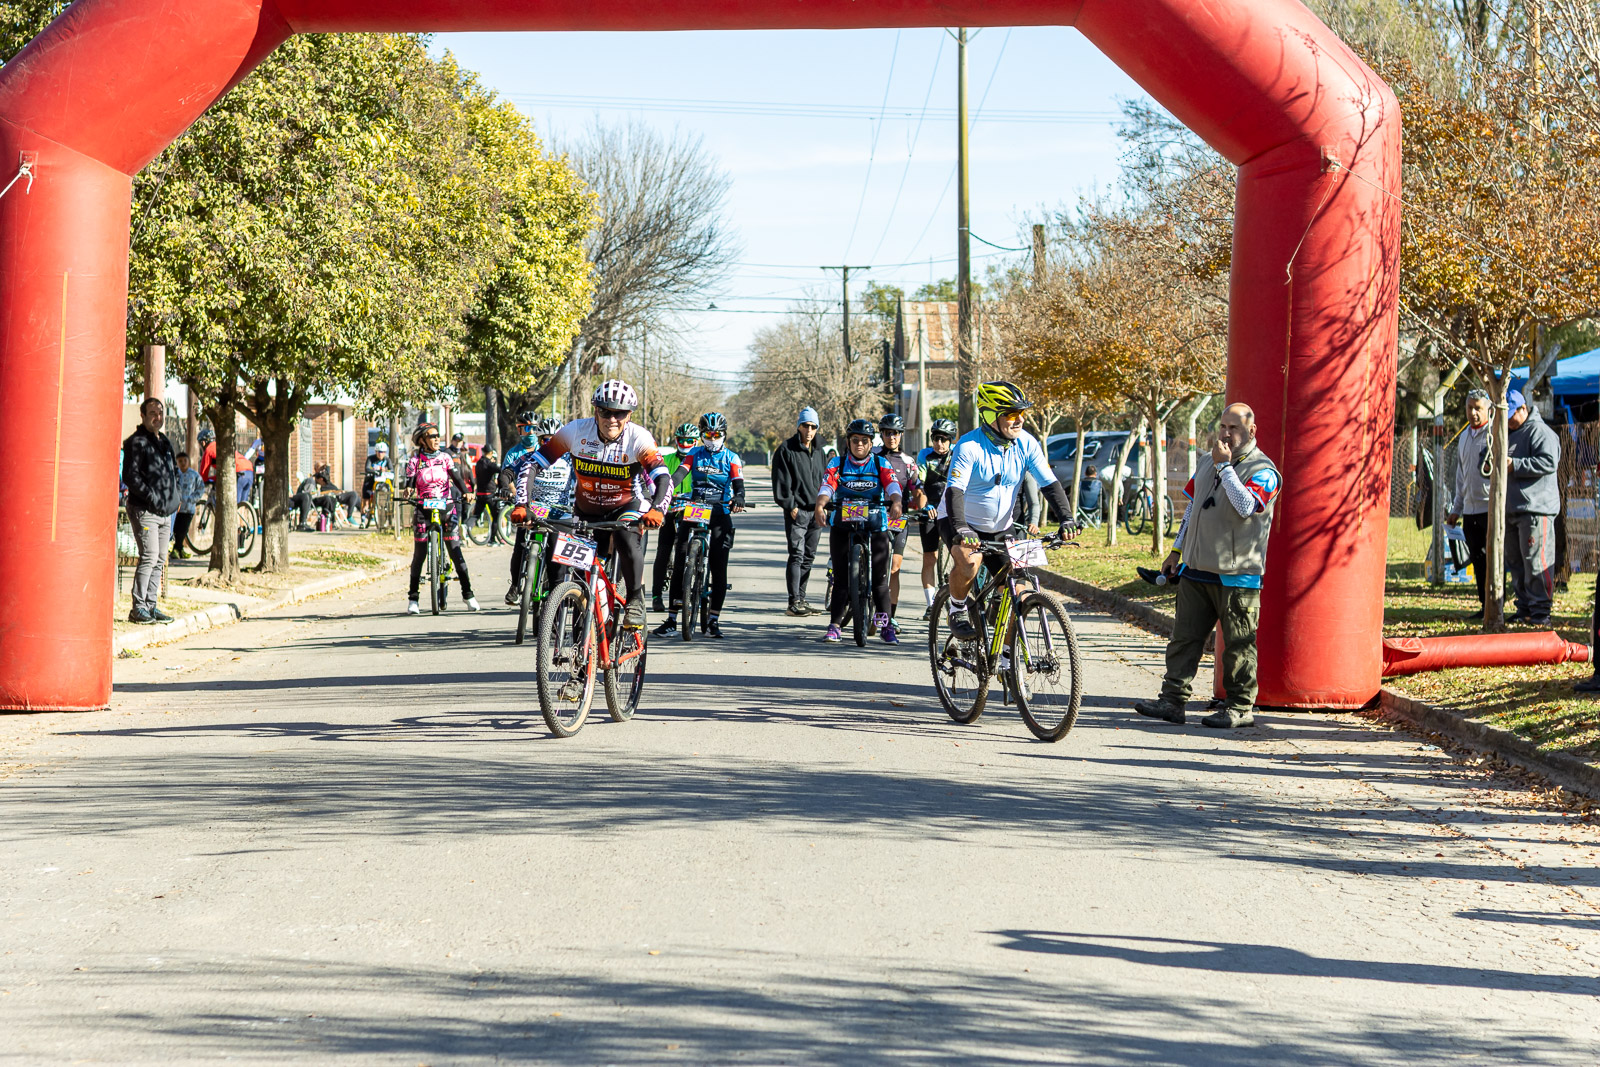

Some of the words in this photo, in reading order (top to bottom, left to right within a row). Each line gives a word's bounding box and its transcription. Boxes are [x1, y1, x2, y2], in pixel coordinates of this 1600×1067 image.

[576, 458, 631, 479] PELOTONBIKE
[690, 507, 705, 518] 15
[561, 543, 590, 561] 85
